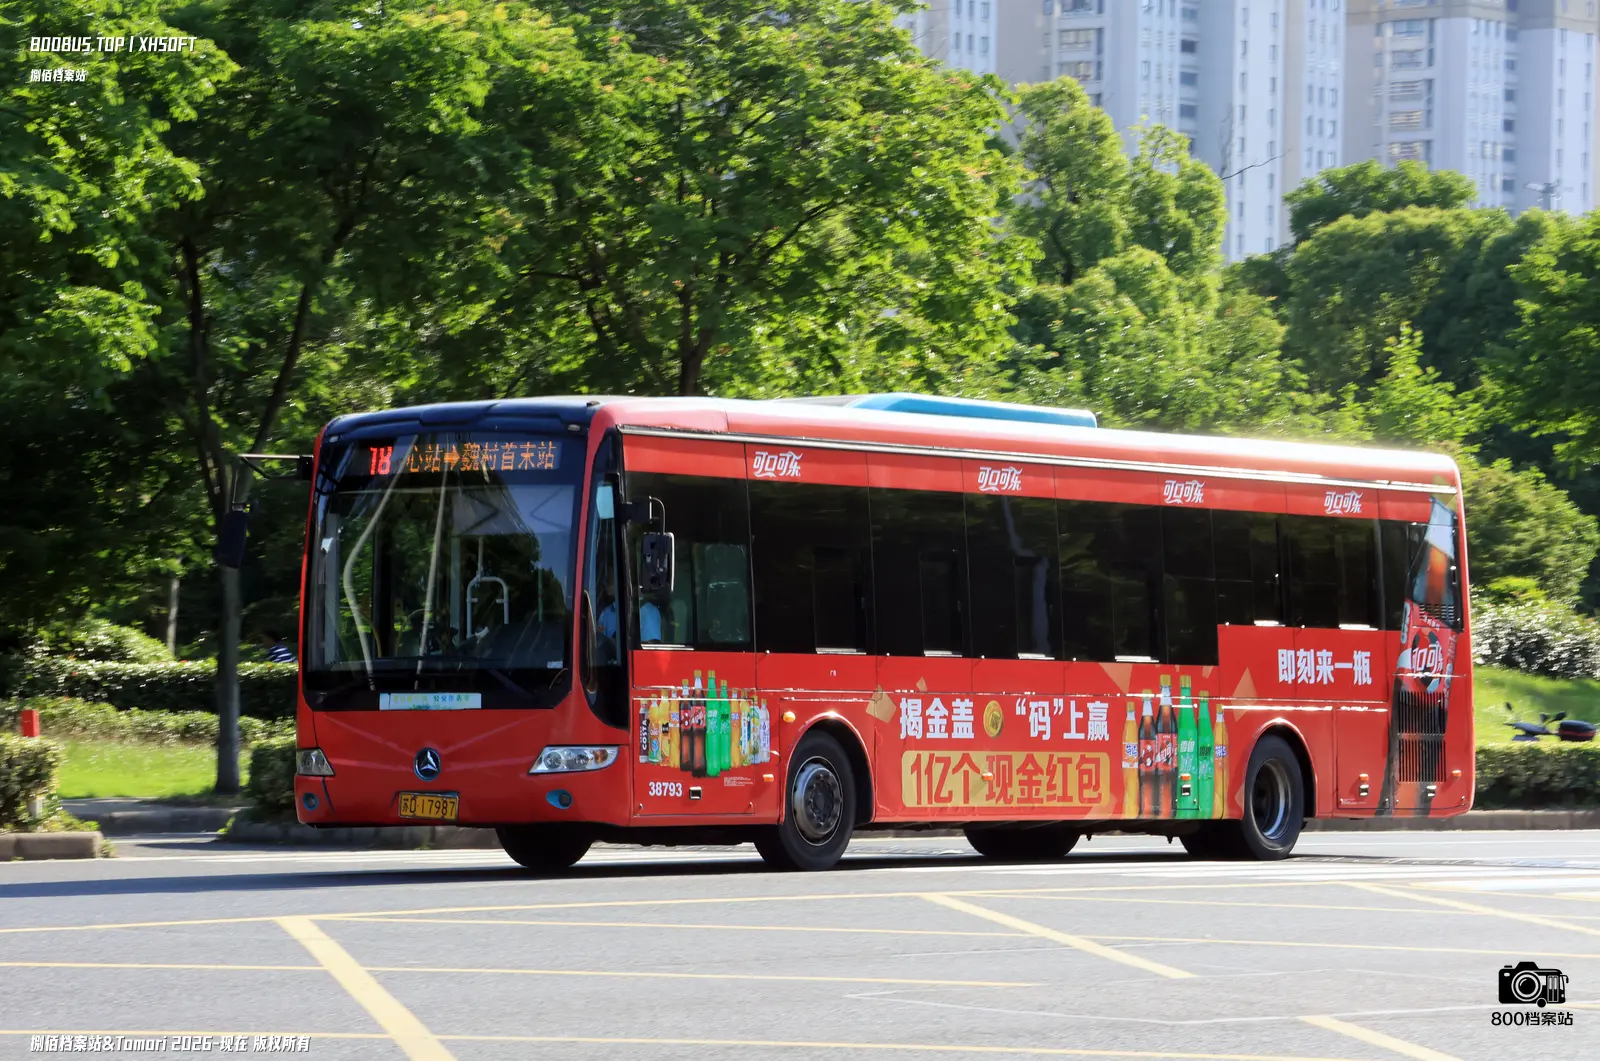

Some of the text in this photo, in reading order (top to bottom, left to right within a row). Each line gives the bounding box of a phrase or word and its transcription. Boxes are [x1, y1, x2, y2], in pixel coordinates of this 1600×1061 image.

[369, 446, 393, 476] 18
[753, 451, 803, 478] 可口可乐
[977, 466, 1023, 492] 可口可乐
[1163, 479, 1206, 504] 可口可乐
[1324, 490, 1363, 514] 可口可乐
[1277, 648, 1373, 686] 即刻来一瓶
[899, 697, 976, 740] 揭金盖
[648, 781, 683, 797] 38793
[910, 752, 1103, 806] 1亿个现金红包
